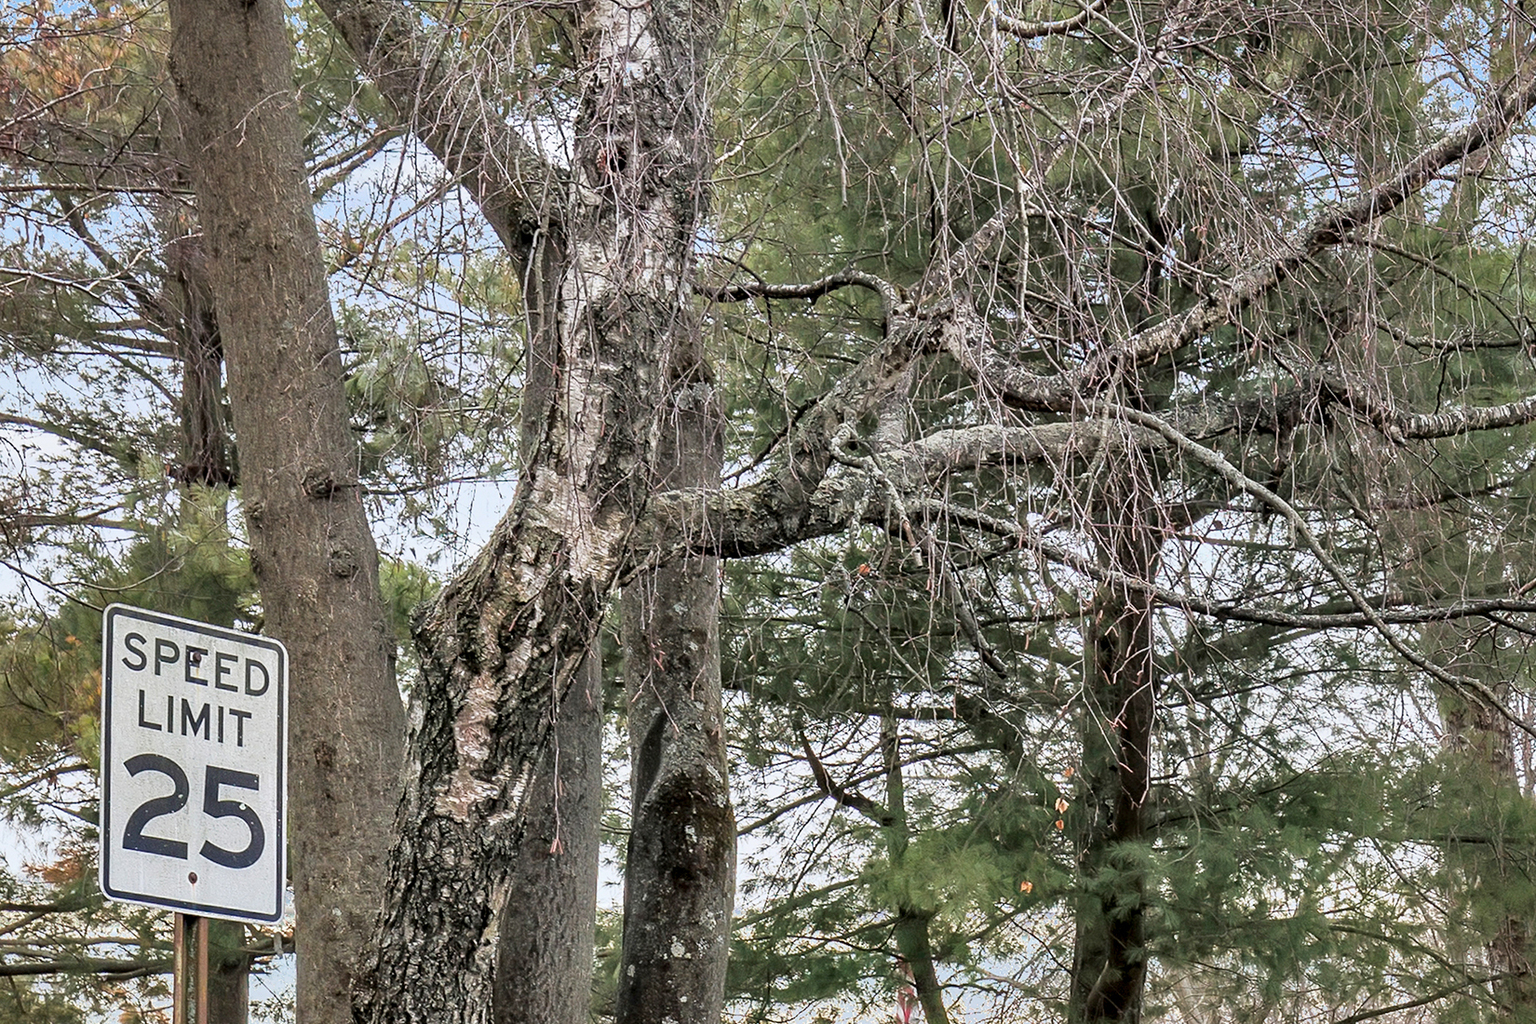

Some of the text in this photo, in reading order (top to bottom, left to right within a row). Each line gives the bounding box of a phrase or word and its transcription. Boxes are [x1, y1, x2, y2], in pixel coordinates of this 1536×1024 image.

[121, 631, 270, 697] SPEED
[138, 689, 252, 747] LIMIT
[121, 753, 266, 869] 25
